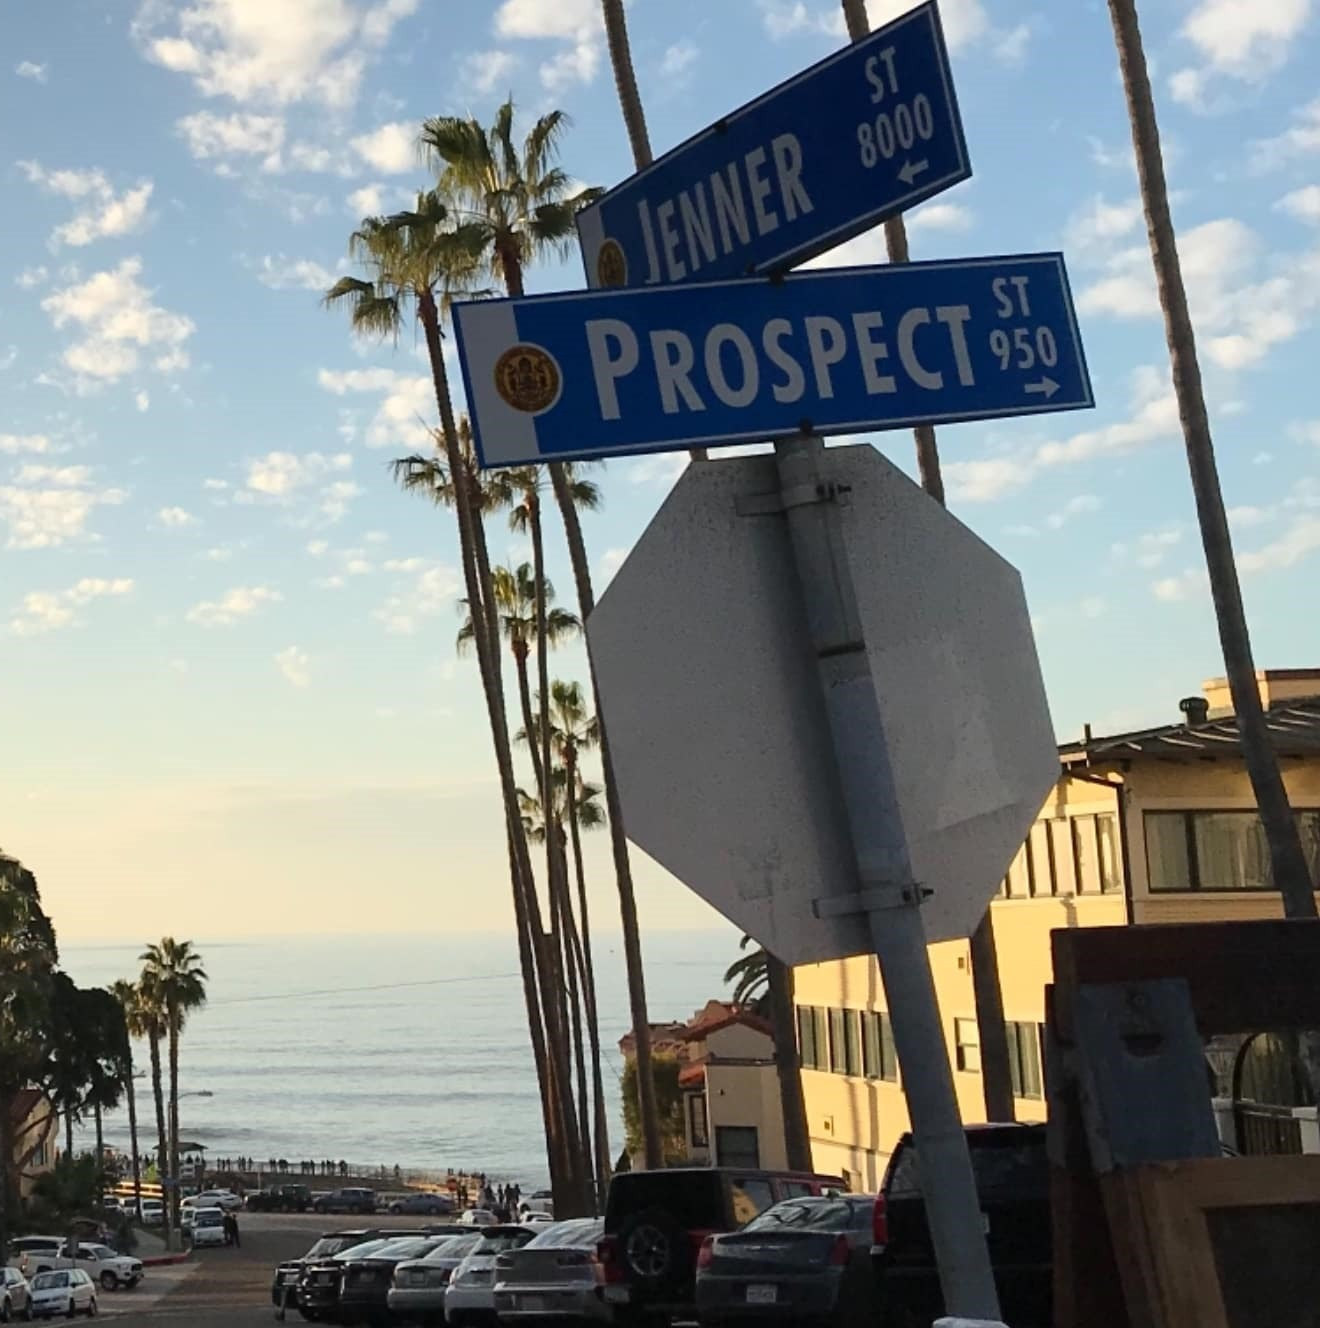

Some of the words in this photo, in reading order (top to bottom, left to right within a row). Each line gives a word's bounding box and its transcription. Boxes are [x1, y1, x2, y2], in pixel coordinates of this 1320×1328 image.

[636, 132, 814, 285] JENNER
[865, 47, 900, 104] ST
[857, 93, 934, 169] 8000
[586, 305, 976, 421] PROSPECT
[991, 276, 1030, 319] ST
[990, 326, 1058, 371] 950
